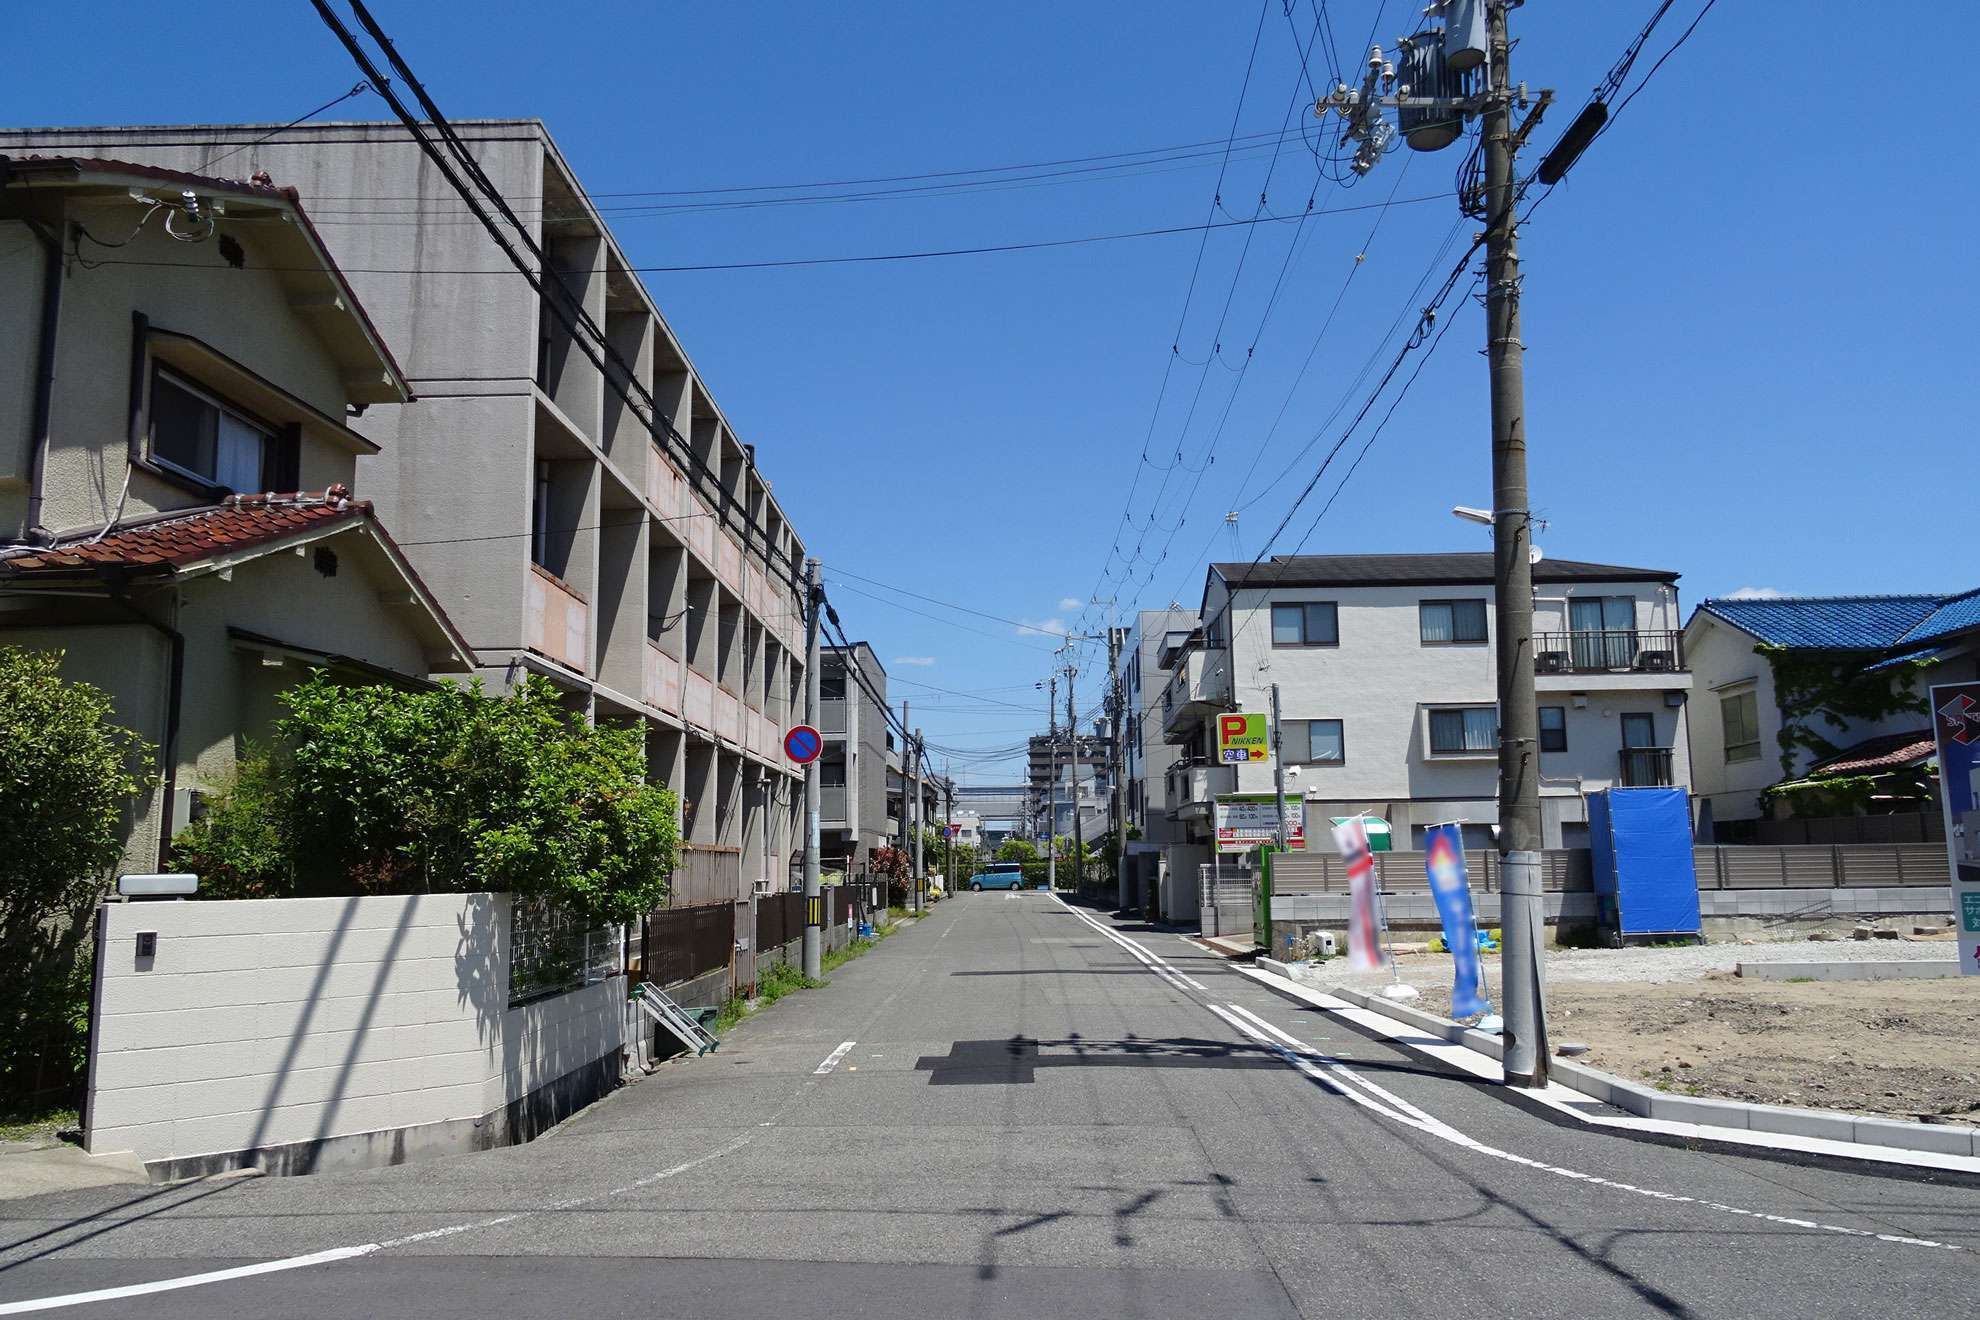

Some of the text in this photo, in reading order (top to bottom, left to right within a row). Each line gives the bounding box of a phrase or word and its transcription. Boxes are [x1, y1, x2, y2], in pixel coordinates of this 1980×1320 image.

[1221, 716, 1247, 745] P
[1231, 736, 1264, 745] NIKKEN
[1223, 749, 1247, 761] 空車
